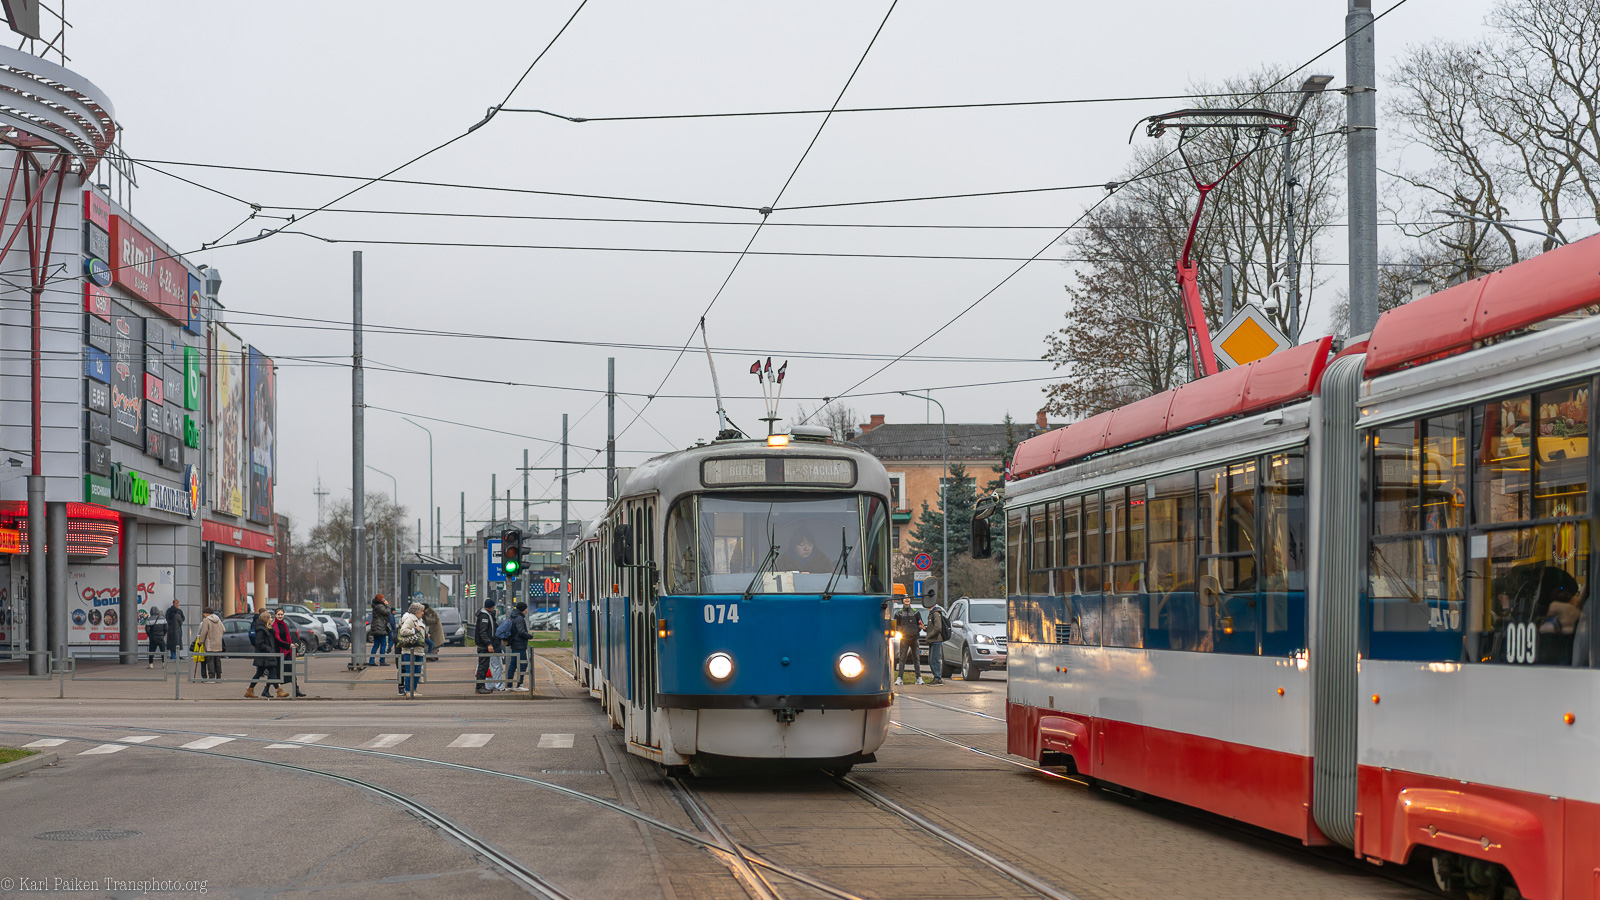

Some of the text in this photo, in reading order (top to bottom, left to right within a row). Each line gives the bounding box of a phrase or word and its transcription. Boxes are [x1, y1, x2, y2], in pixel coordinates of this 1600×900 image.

[134, 276, 149, 295] SUPER
[112, 462, 149, 506] DinoZoo
[82, 581, 155, 605] orage
[772, 574, 783, 593] 1
[704, 603, 739, 624] 074
[1506, 621, 1537, 664] 009
